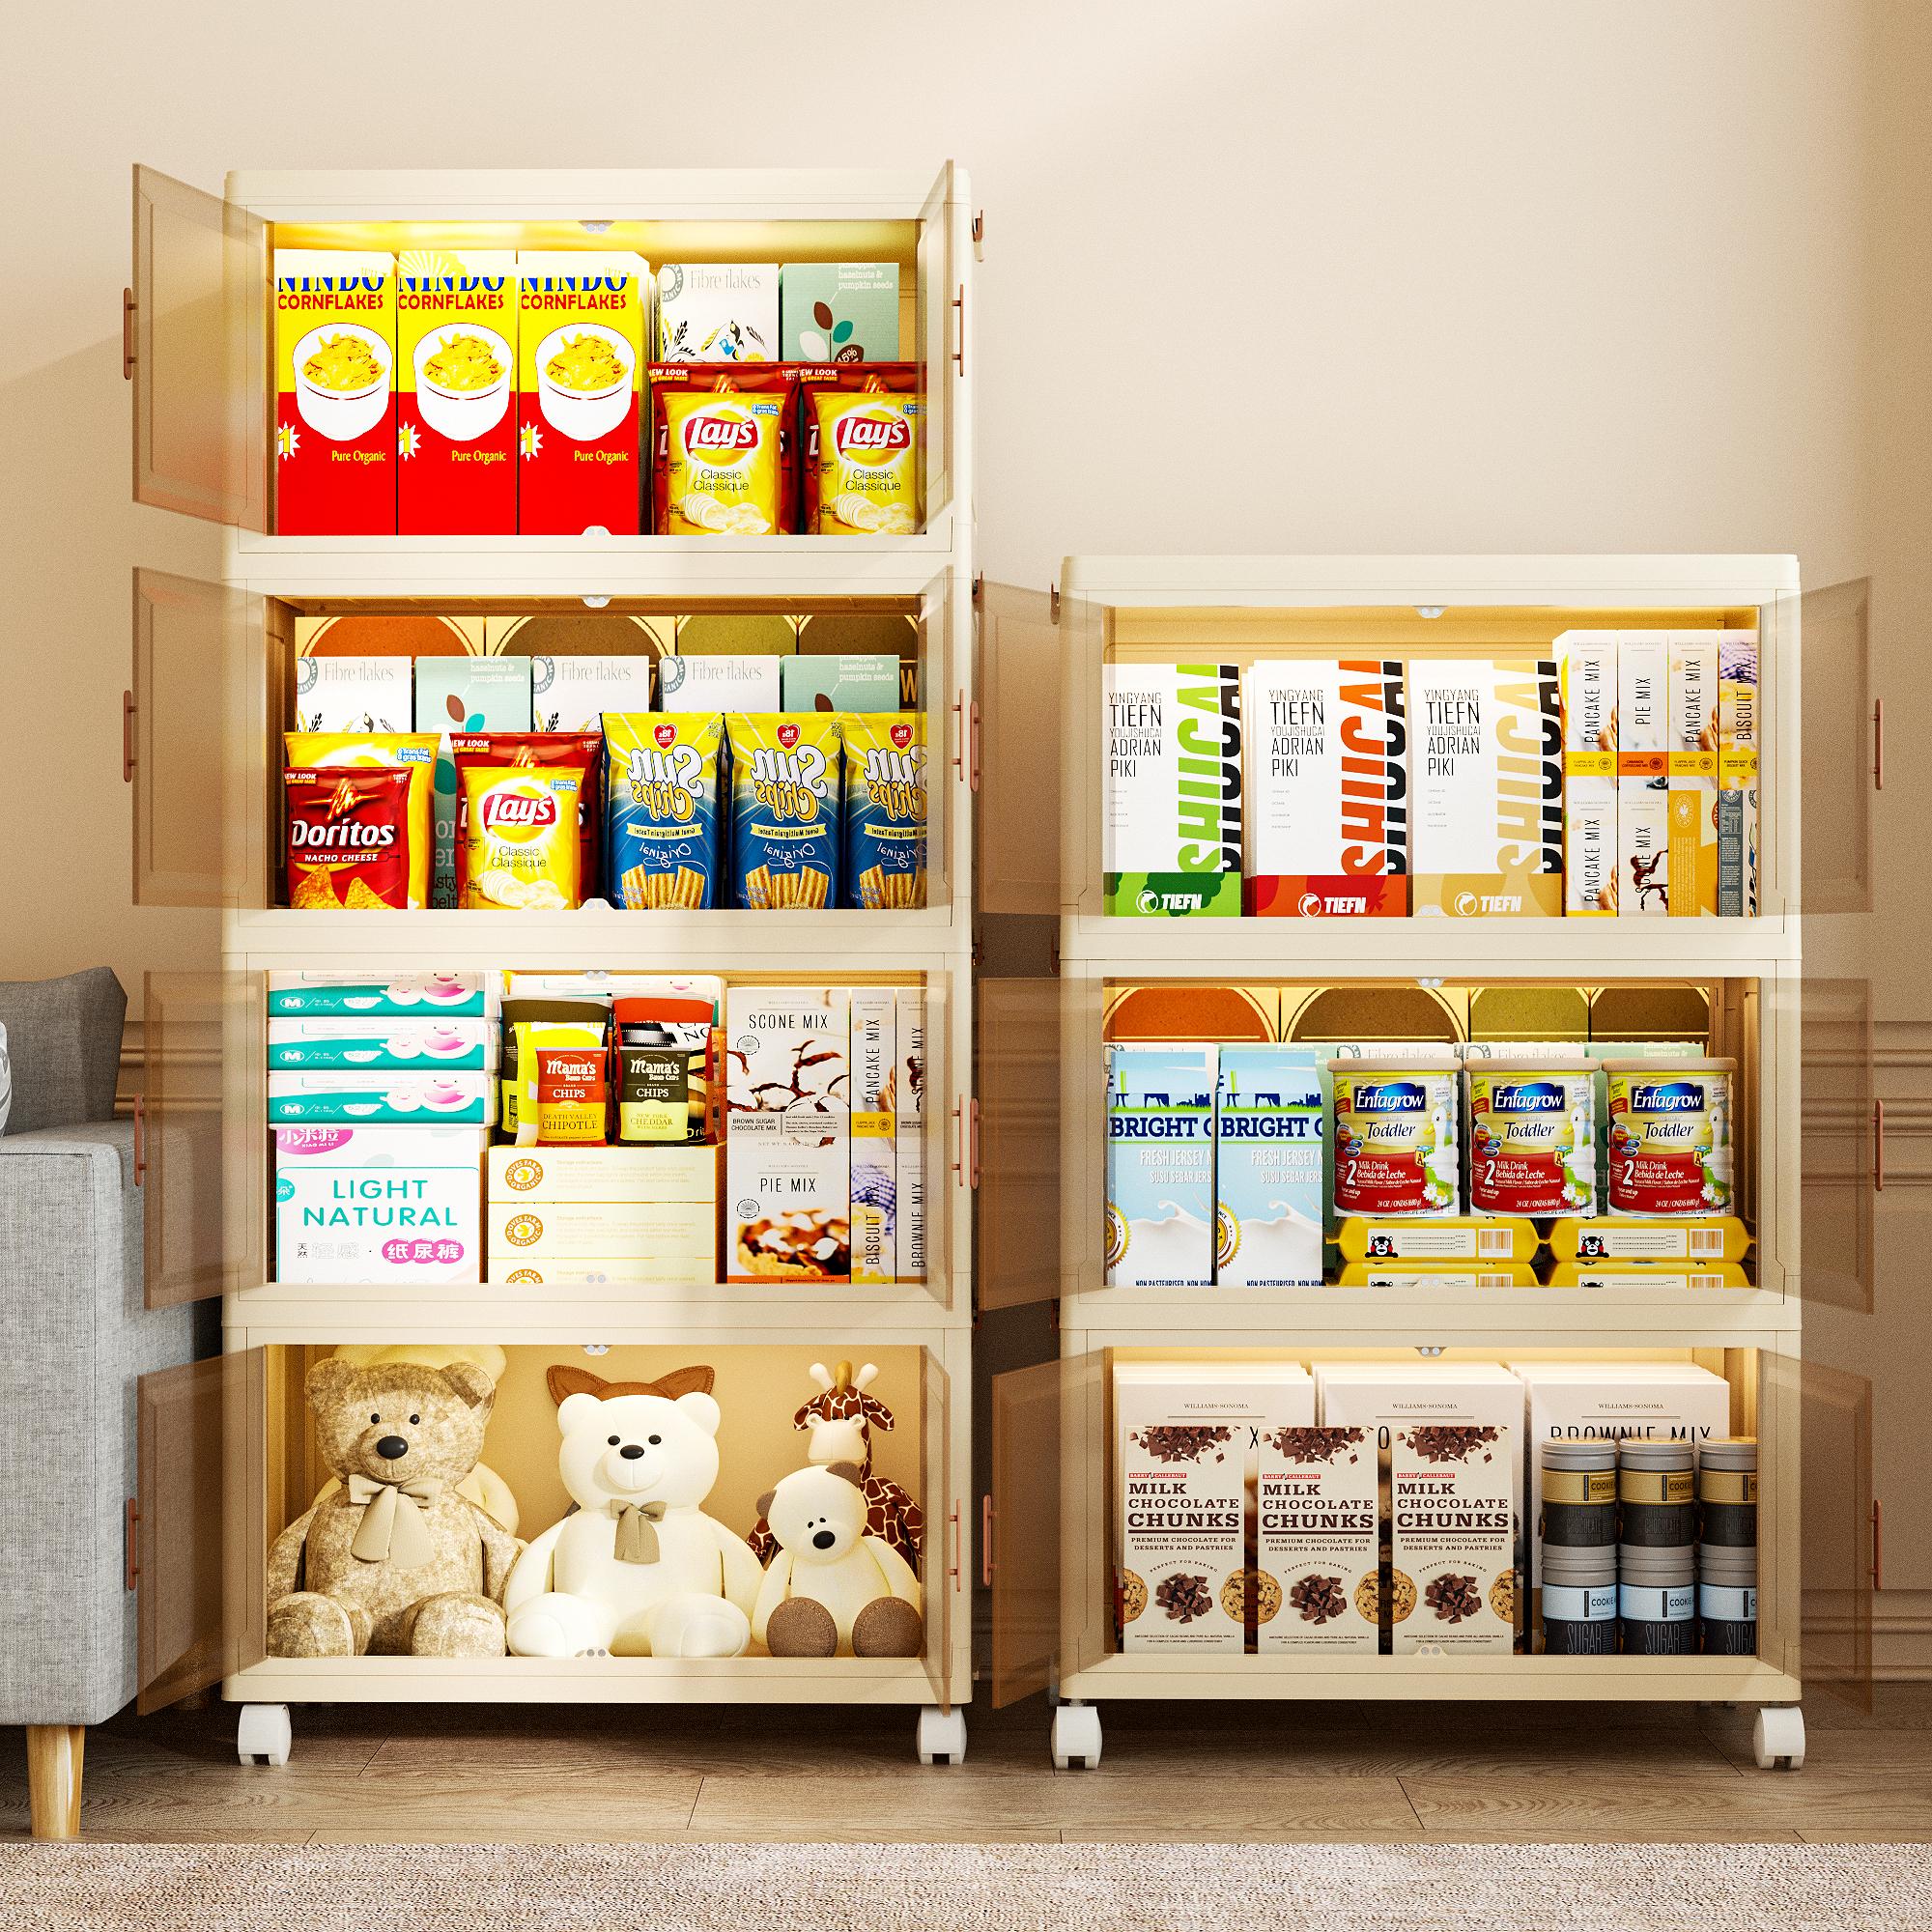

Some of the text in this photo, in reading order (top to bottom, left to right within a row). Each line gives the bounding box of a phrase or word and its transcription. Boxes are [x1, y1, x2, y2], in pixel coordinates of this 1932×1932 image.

[691, 269, 761, 289] Fibre flakes
[838, 280, 894, 291] pumpkin seeds
[278, 294, 384, 310] CORNFLAKES
[399, 294, 504, 310] CORNFLAKES
[522, 294, 627, 310] CORNFLAKES
[278, 428, 291, 453] 1
[689, 417, 754, 449] Lay's
[839, 417, 906, 449] Lay's
[331, 449, 386, 466] Pure Organic
[451, 449, 507, 466] Pure Organic
[574, 449, 629, 466] Pure Organic
[700, 469, 742, 480] Classic
[852, 469, 894, 480] Classic
[694, 480, 750, 492] Classique
[845, 480, 901, 492] Classique
[692, 661, 763, 681] Fibre flakes
[1584, 660, 1601, 682] MIX
[1685, 660, 1701, 682] MIX
[1736, 662, 1752, 684] MIX
[1108, 692, 1162, 704] YINGYANG
[1268, 690, 1323, 701] YINGYANG
[1423, 690, 1479, 701] YINGYANG
[1635, 677, 1651, 724] PIE MIX
[1109, 705, 1162, 727] TIEFN
[1269, 702, 1324, 725] TIEFN
[1425, 702, 1480, 724] TIEFN
[1584, 688, 1601, 743] PANCAKE
[1685, 688, 1701, 743] PANCAKE
[1736, 691, 1752, 740] BISCUIT
[1110, 738, 1161, 756] ADRIAN
[1271, 738, 1323, 755] ADRIAN
[1428, 737, 1480, 754] ADRIAN
[1110, 759, 1136, 778] PIKI
[1271, 759, 1298, 777] PIKI
[1428, 757, 1455, 776] PIKI
[486, 794, 554, 827] Lay's
[1635, 827, 1651, 848] MIX
[498, 846, 540, 857] Classic
[492, 857, 547, 869] Classique
[1584, 819, 1601, 902] PANCAKE MIX
[1161, 894, 1202, 910] TIEFN
[1323, 896, 1366, 914] TIEFN
[1479, 895, 1522, 912] TIEFN
[749, 1014, 829, 1029] SCONE MIX
[546, 1059, 597, 1075] Mama's
[630, 1059, 680, 1074] Mama's
[866, 1018, 880, 1103] PANCAKE MIX
[553, 1089, 585, 1098] CHIPS
[636, 1088, 669, 1097] CHIPS
[1355, 1088, 1425, 1111] Enfagrow
[1494, 1088, 1563, 1111] Enfagrow
[1634, 1088, 1702, 1111] Enfagrow
[542, 1121, 599, 1130] CHIPOTLE
[1110, 1117, 1198, 1138] BRIGHT
[1220, 1117, 1309, 1138] BRIGHT
[1365, 1122, 1416, 1140] Toddler
[1504, 1122, 1555, 1140] Toddler
[1643, 1122, 1694, 1140] Toddler
[1140, 1150, 1205, 1166] FRESH JERSEY
[1251, 1150, 1315, 1166] FRESH JERSEY
[1496, 1161, 1528, 1170] Milk Drink
[1635, 1161, 1667, 1170] Milk Drink
[1346, 1159, 1357, 1186] 2
[1484, 1159, 1495, 1186] 2
[1495, 1170, 1546, 1179] Bebida de Leche
[1623, 1159, 1634, 1186] 2
[1634, 1170, 1685, 1179] Bebida de Leche
[333, 1179, 428, 1199] LIGHT
[760, 1178, 816, 1193] PIE MIX
[303, 1207, 458, 1227] NATURAL
[866, 1185, 880, 1264] BISCUIT MIX
[911, 1182, 925, 1267] BROWNIE MIX
[386, 1243, 460, 1260] 纸尿裤
[1128, 1483, 1187, 1494] MILK
[1263, 1484, 1321, 1495] MILK
[1397, 1483, 1456, 1494] MILK
[1128, 1498, 1239, 1509] CHOCOLATE
[1263, 1499, 1374, 1510] CHOCOLATE
[1397, 1498, 1508, 1509] CHOCOLATE
[1128, 1513, 1239, 1527] CHUNKS
[1263, 1514, 1374, 1528] CHUNKS
[1397, 1513, 1508, 1527] CHUNKS
[1591, 1598, 1613, 1606] COOKIE
[1567, 1623, 1602, 1655] SUGAR
[1645, 1623, 1680, 1655] SUGAR
